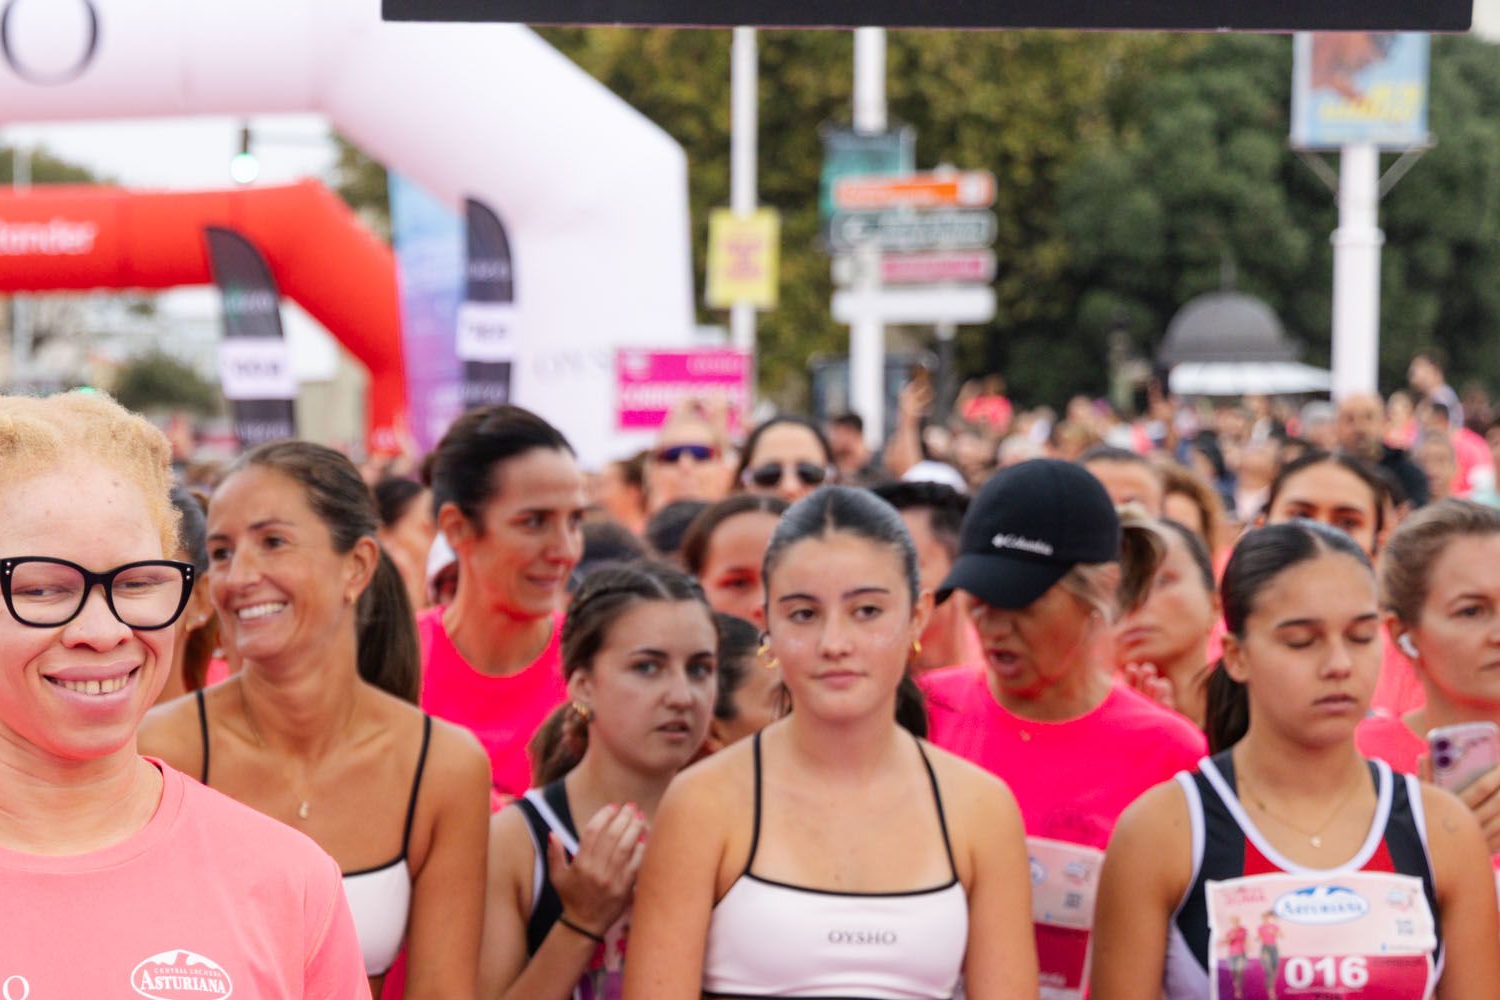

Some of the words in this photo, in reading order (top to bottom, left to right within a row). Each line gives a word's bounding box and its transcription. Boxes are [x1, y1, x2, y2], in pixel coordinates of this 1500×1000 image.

[828, 930, 897, 946] OYSHO
[140, 969, 227, 995] ASTURIANA
[1284, 957, 1369, 989] 016
